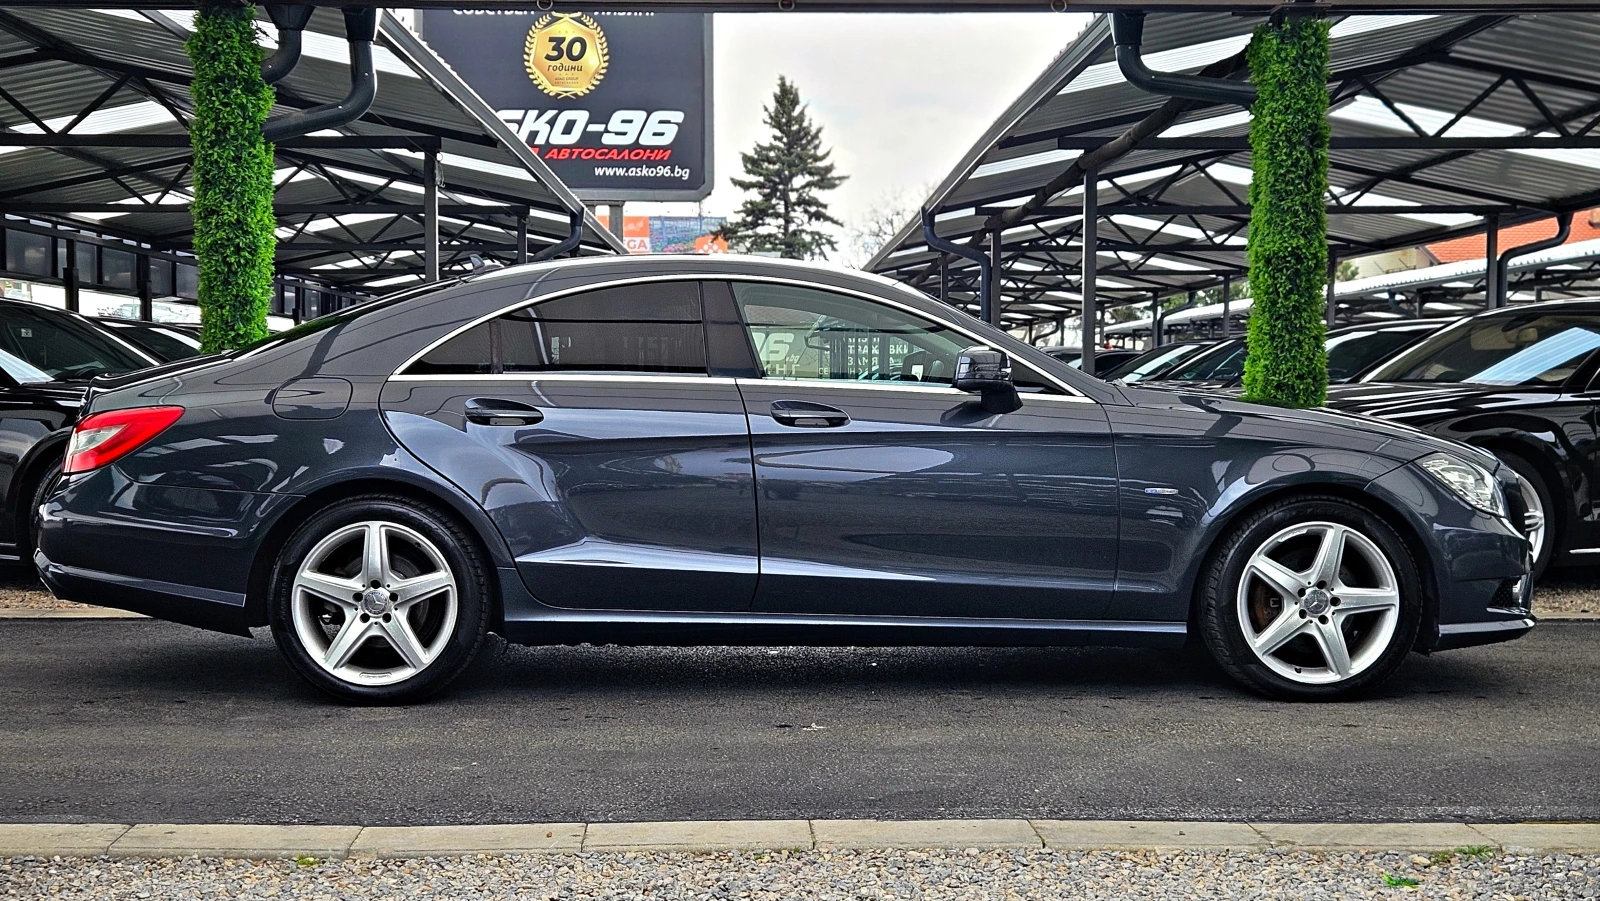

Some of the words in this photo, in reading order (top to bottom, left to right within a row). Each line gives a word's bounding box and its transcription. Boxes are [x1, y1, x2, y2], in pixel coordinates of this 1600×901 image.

[544, 36, 587, 61] 30
[547, 62, 583, 72] години
[544, 147, 672, 161] АВТОСАЛОНИ
[594, 164, 690, 180] www.asko96.bg
[624, 239, 648, 250] GA
